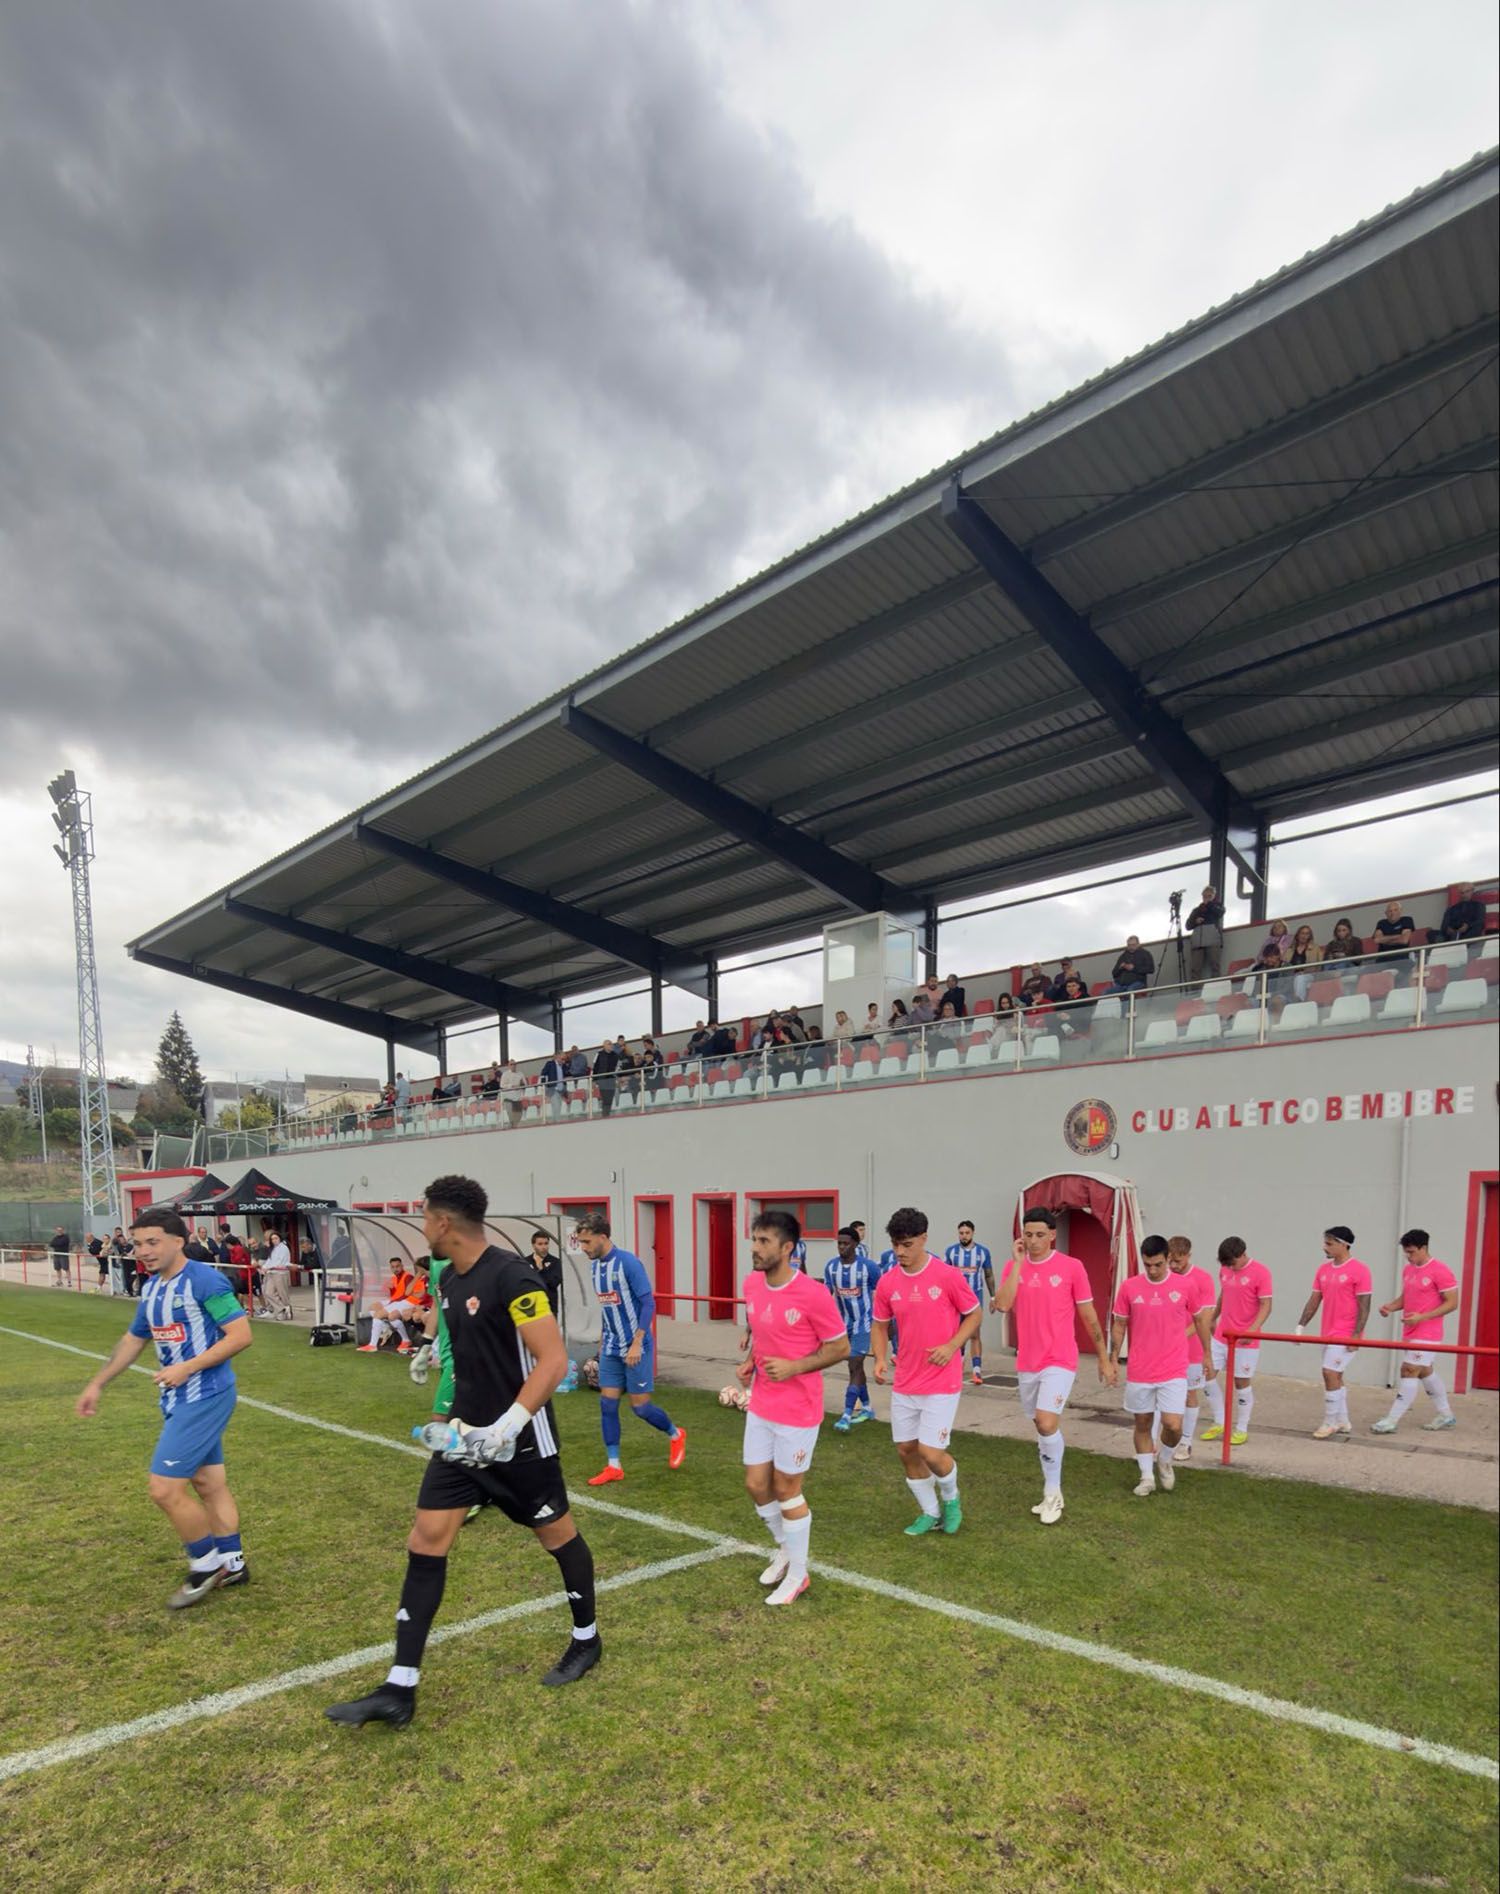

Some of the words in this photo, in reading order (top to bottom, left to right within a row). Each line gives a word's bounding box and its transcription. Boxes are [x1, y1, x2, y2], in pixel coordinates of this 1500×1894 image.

[1132, 1108, 1189, 1133] CLUB
[1195, 1098, 1319, 1129] ATLÉTICO
[1325, 1086, 1474, 1121] BEMBIBRE
